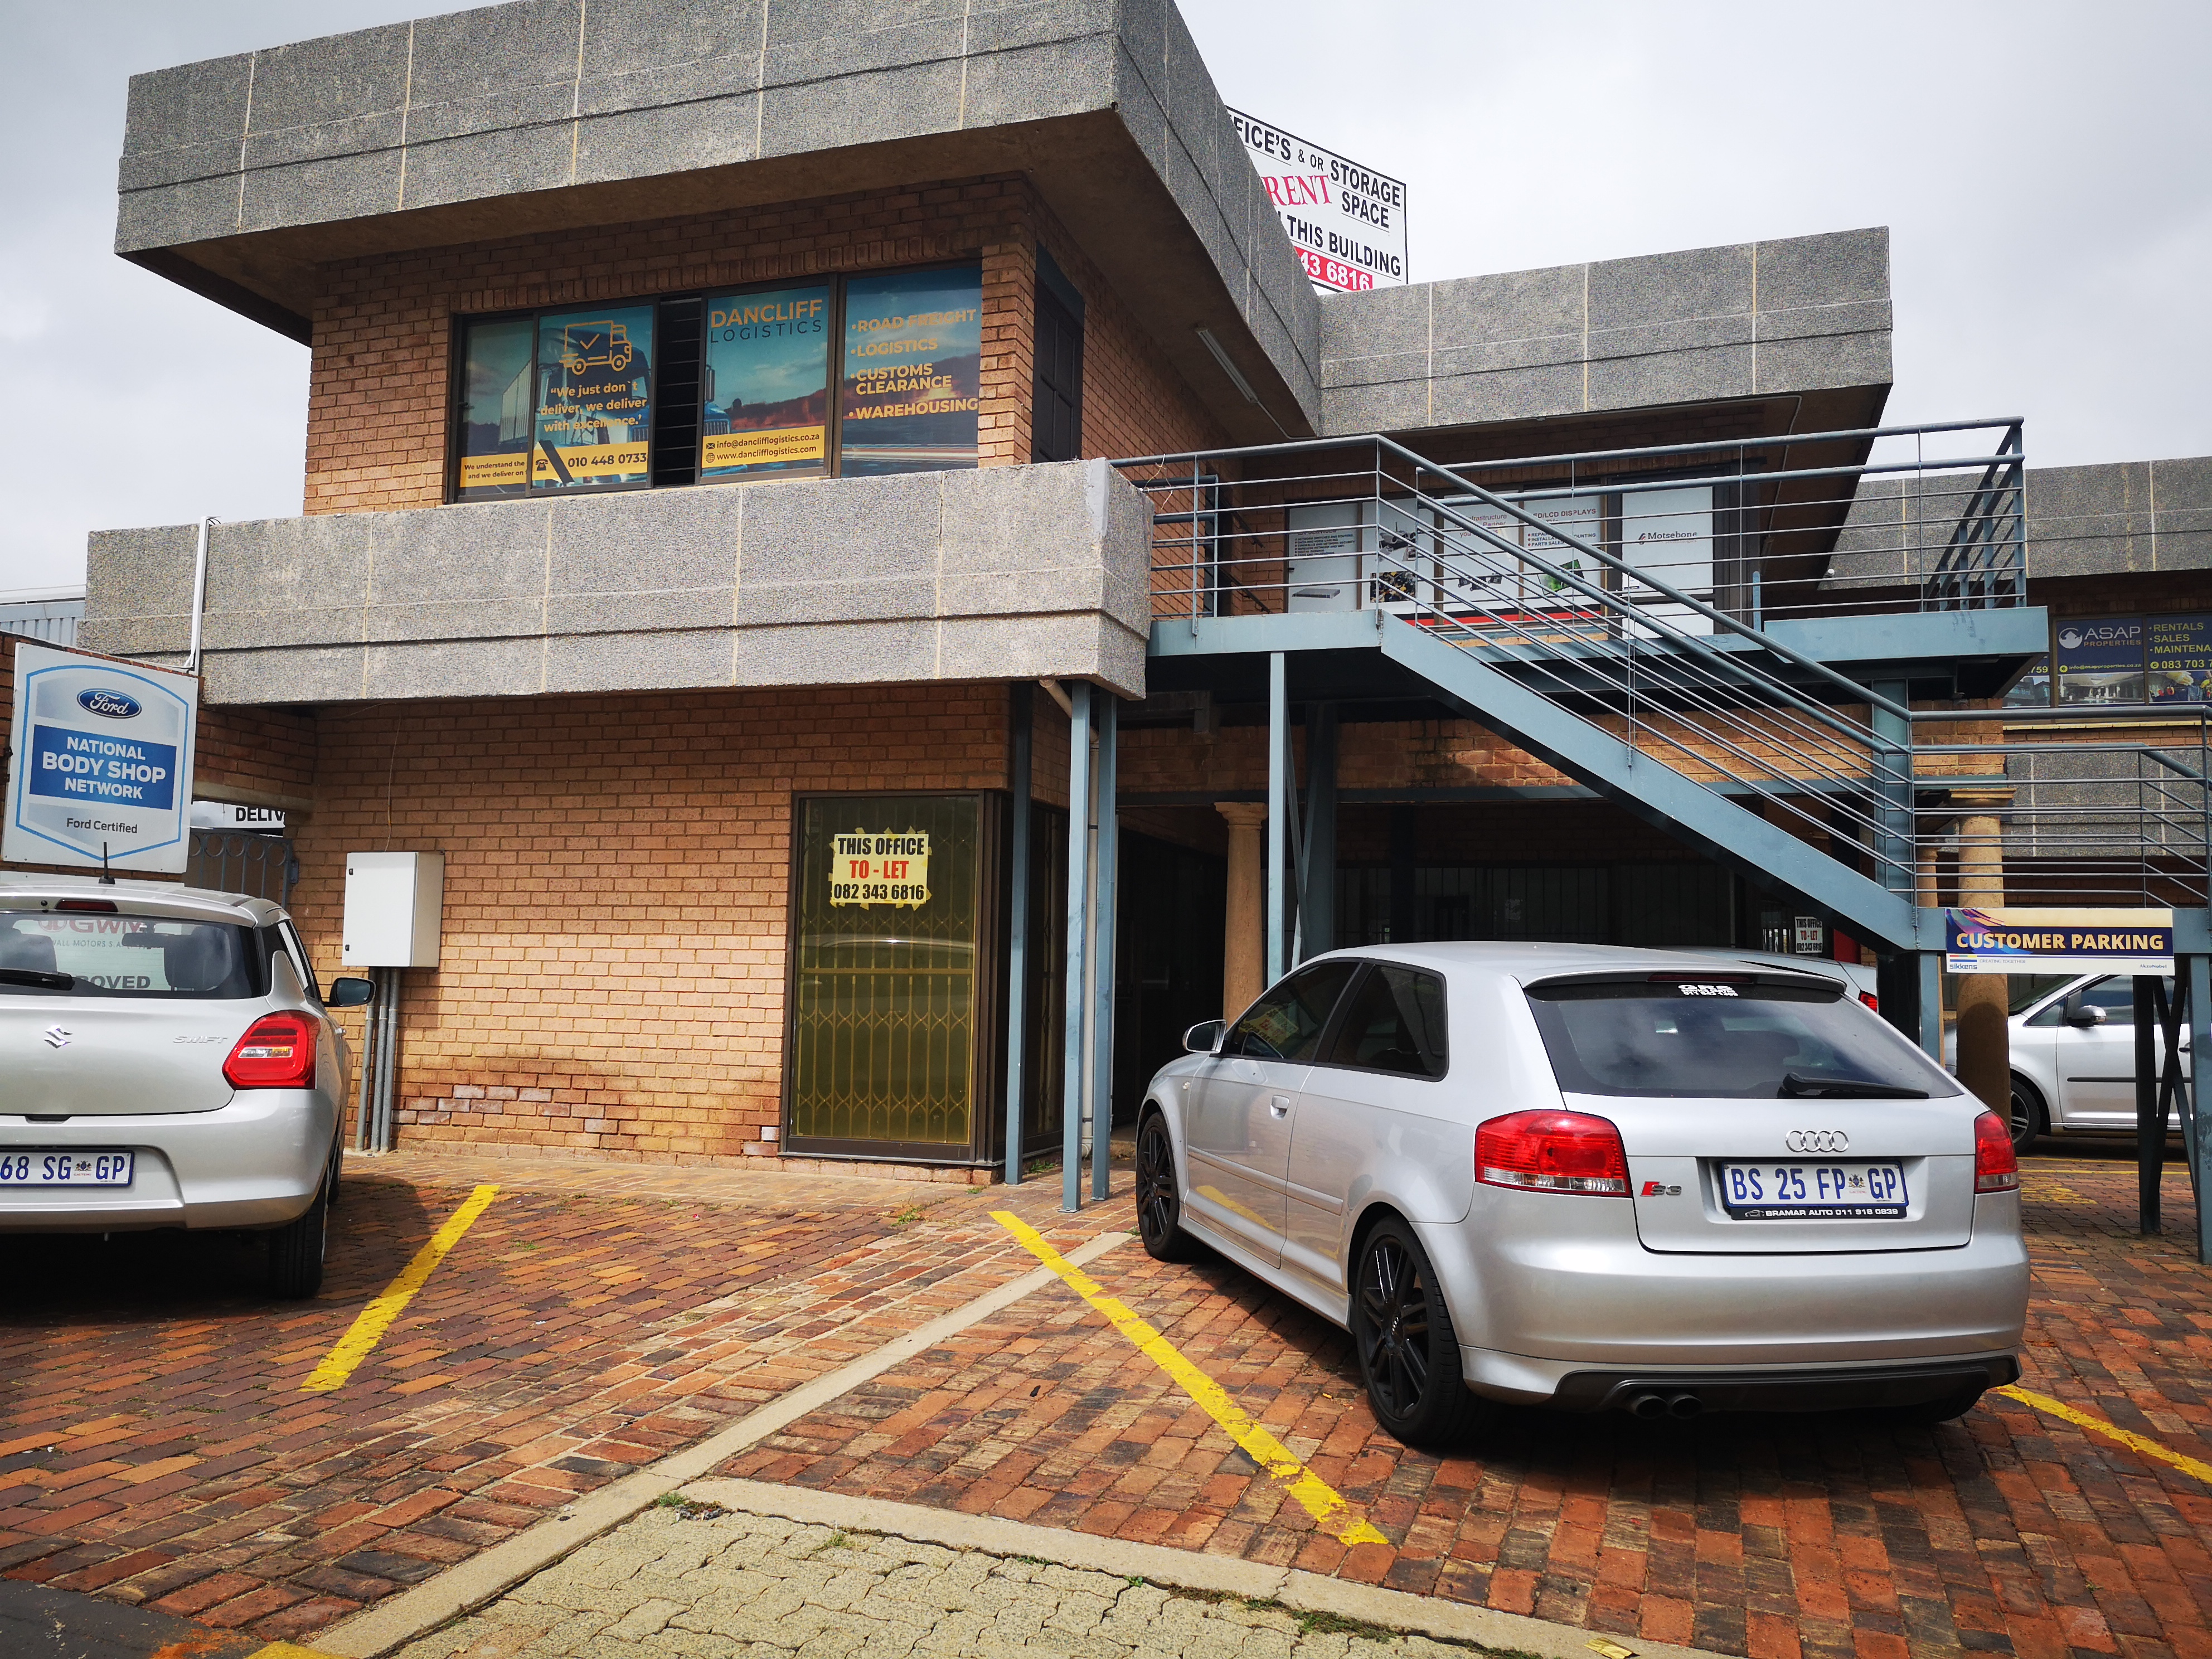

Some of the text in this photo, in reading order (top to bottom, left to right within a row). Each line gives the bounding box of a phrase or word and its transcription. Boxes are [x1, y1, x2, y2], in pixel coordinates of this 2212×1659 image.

[1230, 115, 1400, 207] FICE'S & OR STORAGE
[1261, 175, 1332, 206] RENT
[1342, 191, 1390, 229] SPACE
[1287, 215, 1400, 276] THIS BUILDING
[1327, 261, 1370, 290] 6816
[711, 299, 822, 328] DANCLIFF
[858, 309, 976, 332] ROAD FREIGHT
[711, 319, 822, 343] LOGISTICS
[857, 338, 938, 357] LOGISTICS
[856, 363, 933, 381] CUSTOMS
[577, 385, 600, 398] just
[856, 375, 952, 395] CLEARANCE
[540, 398, 647, 416] deliver, we deliver
[856, 397, 979, 420] WAREHOUSING
[544, 419, 570, 432] with
[716, 433, 819, 449] info@danclifflogistics.co.za
[568, 453, 647, 468] 010 448 0733
[716, 446, 817, 460] www.danclifflogistics.com
[476, 461, 513, 469] understand
[1561, 508, 1596, 517] DISPLAYS
[1648, 531, 1697, 540] Motsebone
[2084, 626, 2141, 640] ASAP
[2153, 622, 2204, 632] RENTALS
[2154, 634, 2190, 643] SALES
[2161, 660, 2181, 669] 083
[2185, 659, 2205, 668] 703
[90, 691, 129, 715] Ford
[67, 736, 145, 760] NATIONAL
[42, 752, 166, 784] BODY SHOP
[65, 777, 143, 799] NETWORK
[66, 818, 138, 833] Ford Certified
[837, 837, 924, 855] THIS OFFICE
[849, 860, 870, 879] TO
[883, 860, 909, 879] LET
[834, 883, 924, 900] 082 343 6816
[1796, 918, 1822, 928] THIS OFFICE
[1800, 930, 1807, 940] TO
[1956, 933, 2164, 950] CUSTOMER PARKING
[1, 1156, 125, 1180] 68 SG GP
[1651, 1185, 1682, 1196] S3
[1731, 1168, 1896, 1200] BS 25 FP GP
